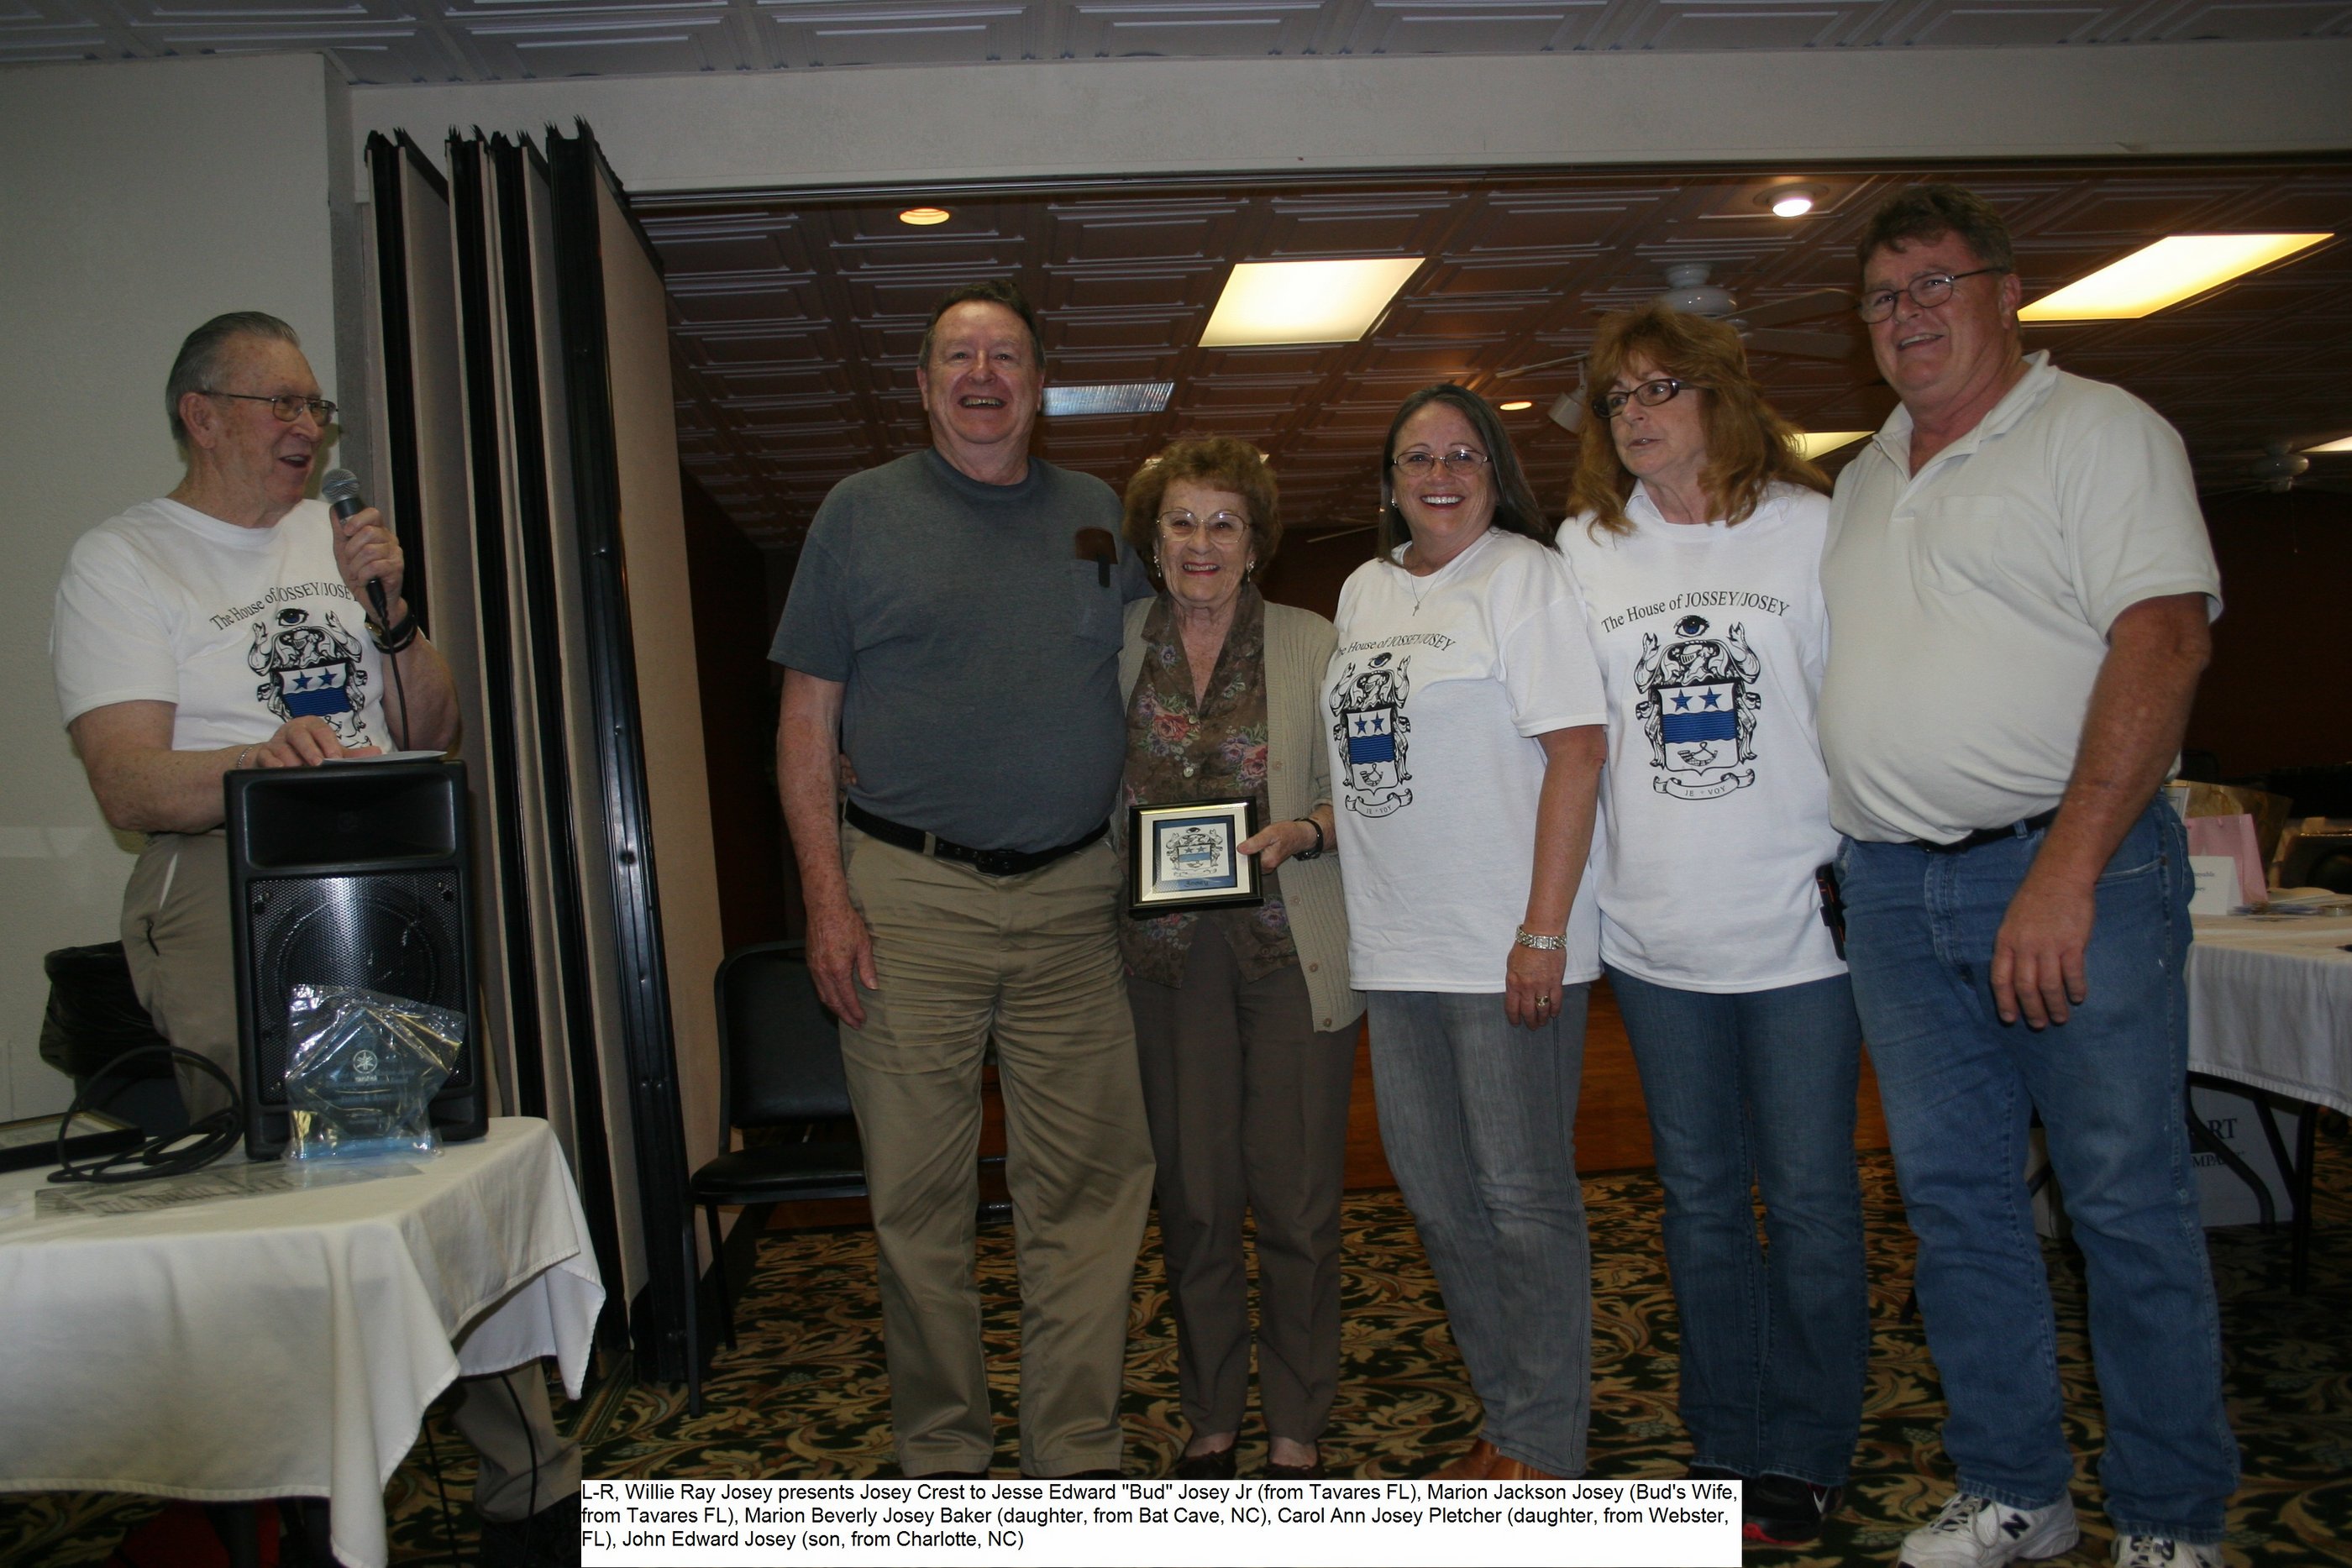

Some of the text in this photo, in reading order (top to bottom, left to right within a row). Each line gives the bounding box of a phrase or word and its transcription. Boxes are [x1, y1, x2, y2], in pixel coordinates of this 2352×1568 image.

[209, 611, 235, 631] The
[229, 600, 265, 621] House
[265, 587, 278, 604] of
[1601, 590, 1790, 633] The House of JOSSEY/JOSEY
[1347, 641, 1377, 653] House
[1377, 637, 1390, 649] of
[1708, 785, 1726, 795] VOY
